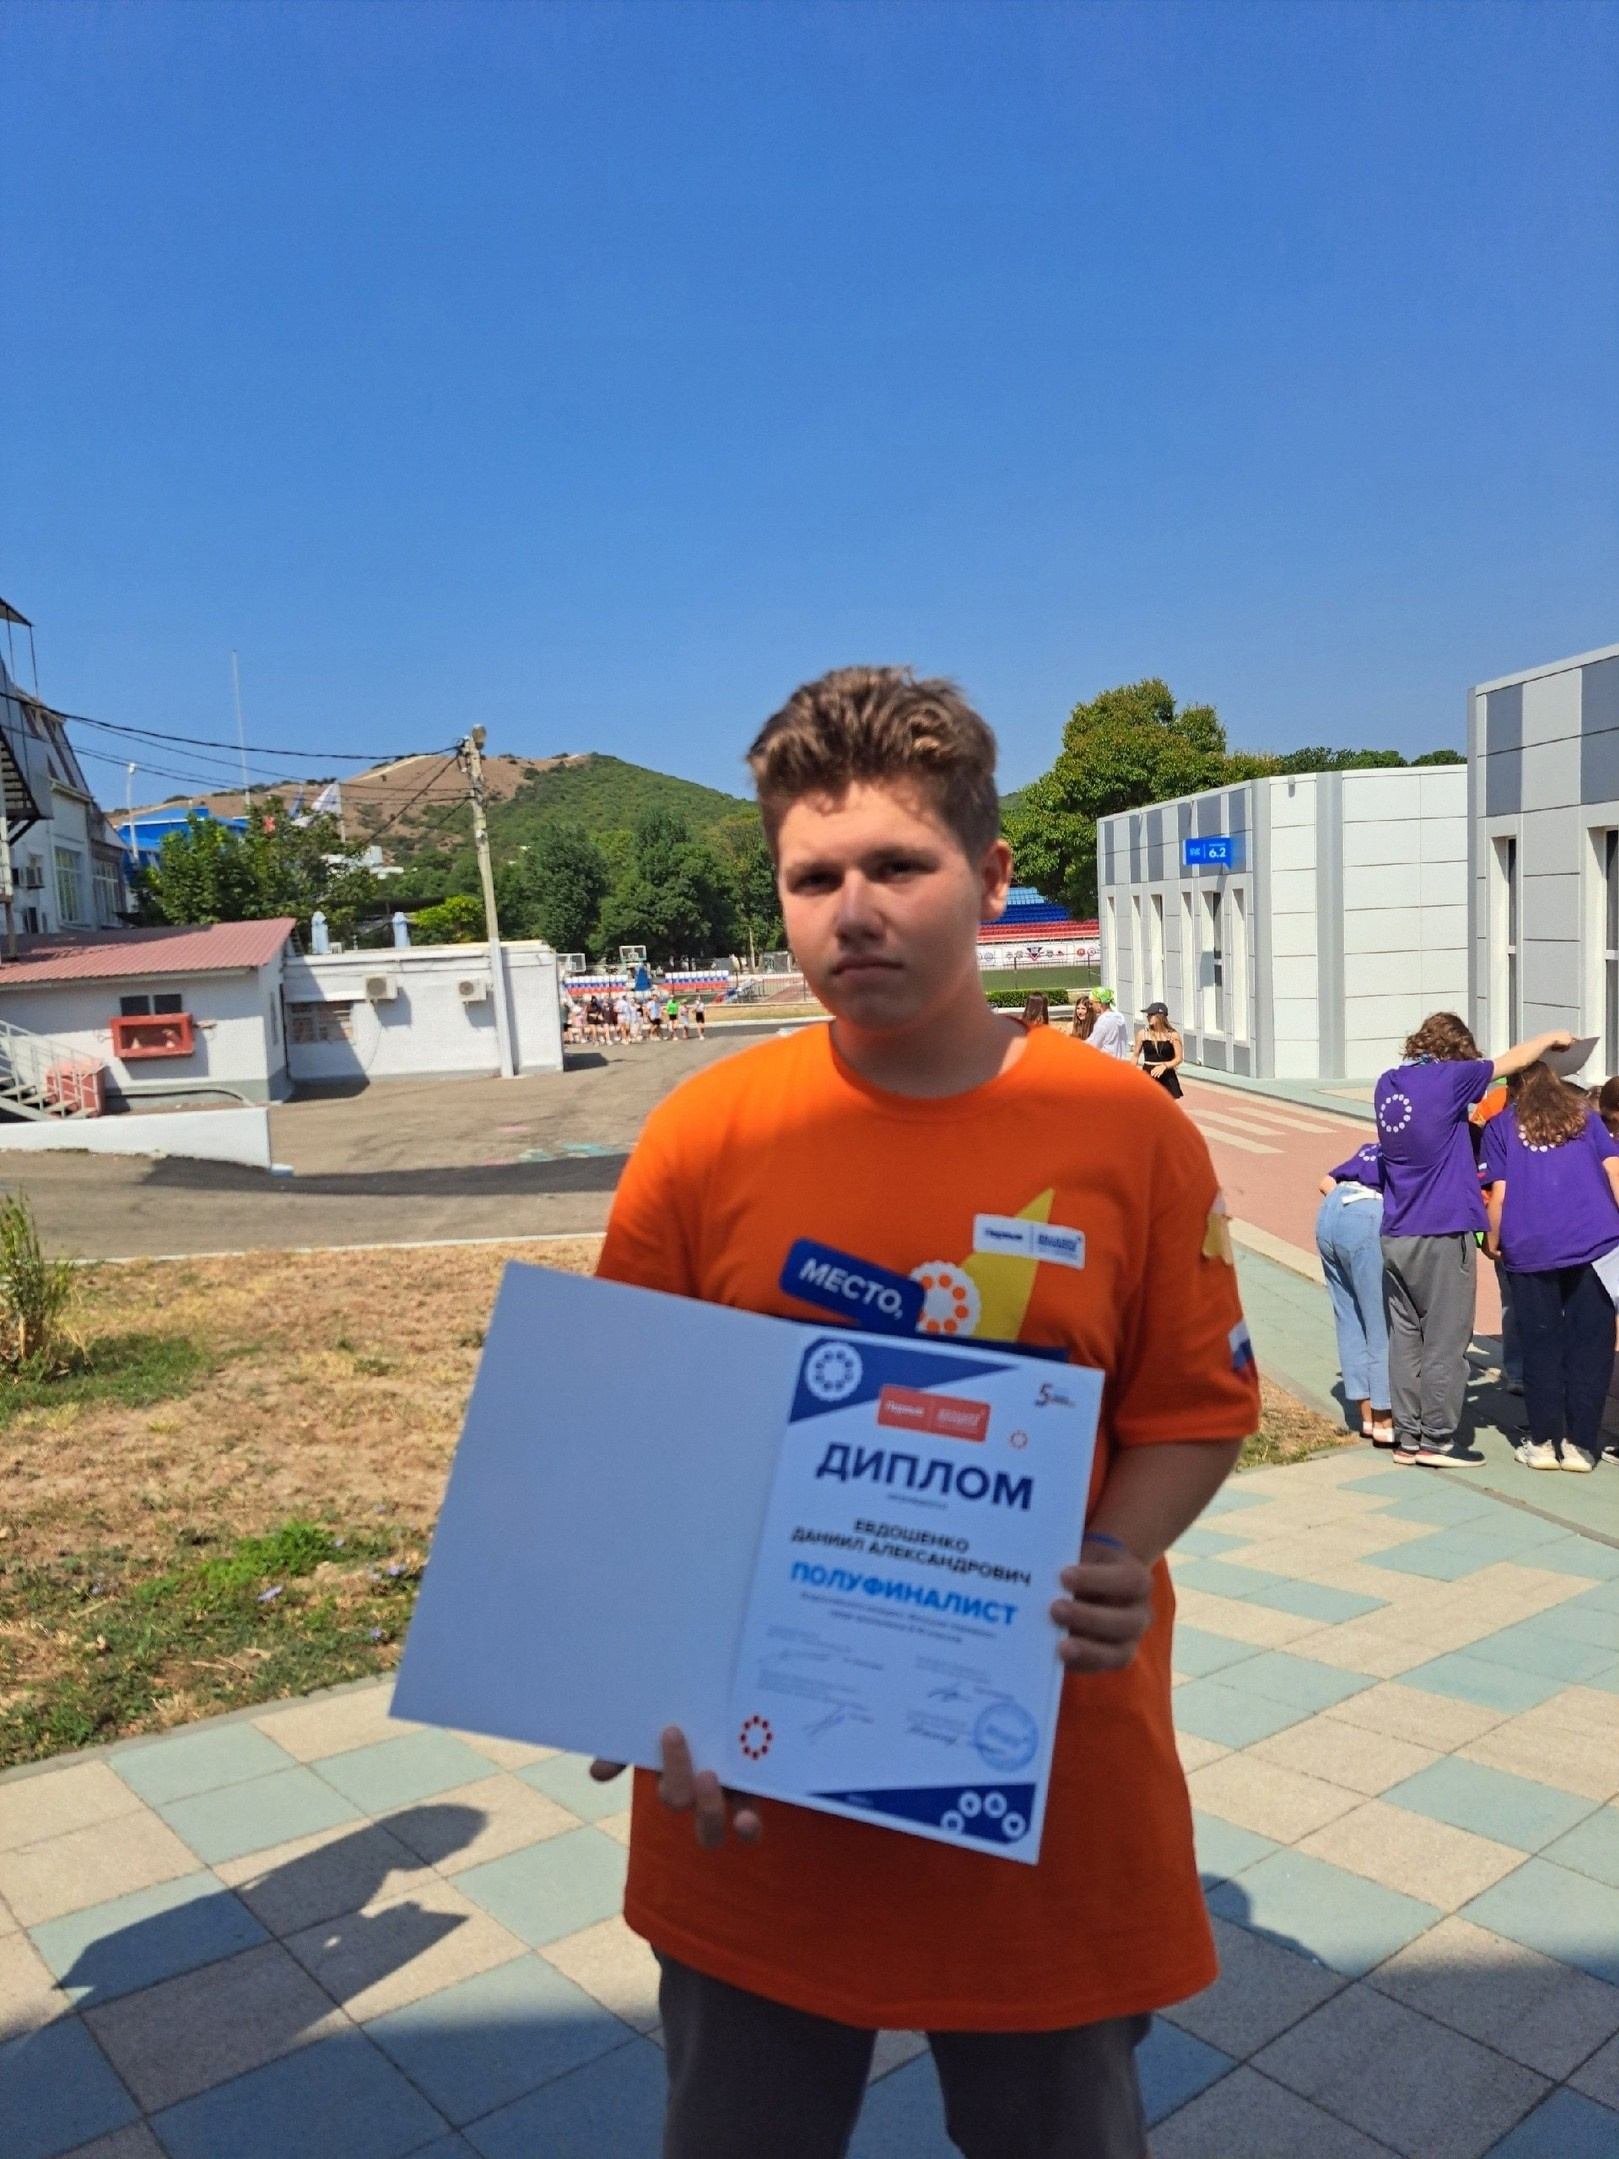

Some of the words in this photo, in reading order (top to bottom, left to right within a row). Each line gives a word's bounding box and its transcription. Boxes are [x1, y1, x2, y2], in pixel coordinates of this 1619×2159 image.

[1208, 847, 1226, 859] 6.2
[798, 1257, 903, 1320] МЕСТО,
[816, 1441, 1034, 1512] ДИПЛОМ
[791, 1526, 865, 1553] ДАНИИЛ
[868, 1538, 1032, 1587] АЛЕКСАНДРОВИЧ
[853, 1517, 970, 1553] ЕВДОШЕНКО
[791, 1561, 1018, 1626] ПОЛУФИНАЛИСТ
